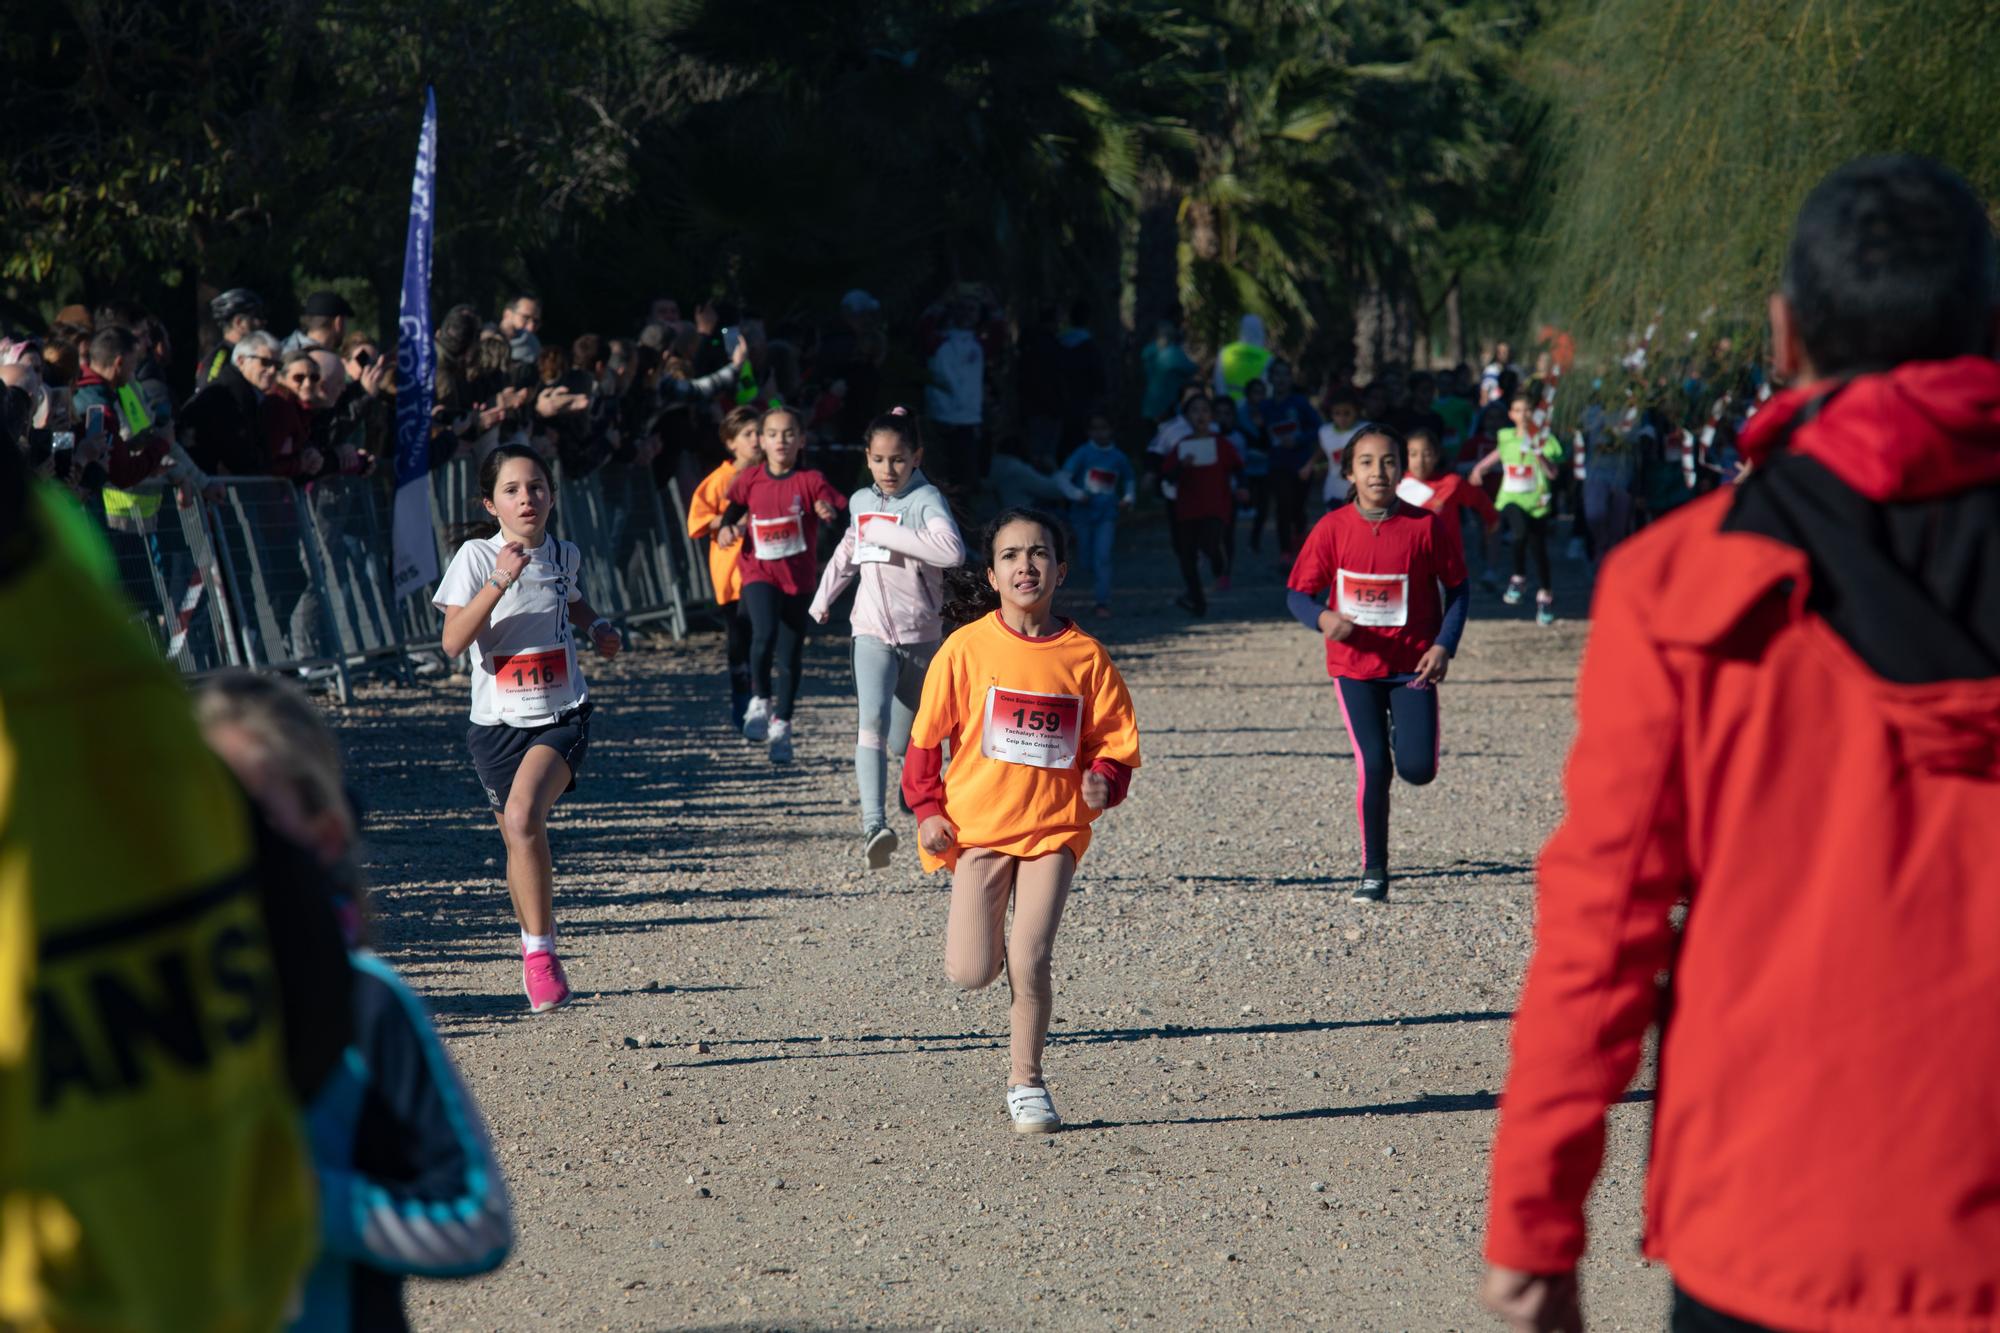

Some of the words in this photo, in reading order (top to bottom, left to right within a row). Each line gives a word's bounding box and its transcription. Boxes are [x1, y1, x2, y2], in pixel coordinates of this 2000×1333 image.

[1354, 588, 1389, 603] 154
[512, 665, 554, 686] 116
[1012, 708, 1060, 732] 159
